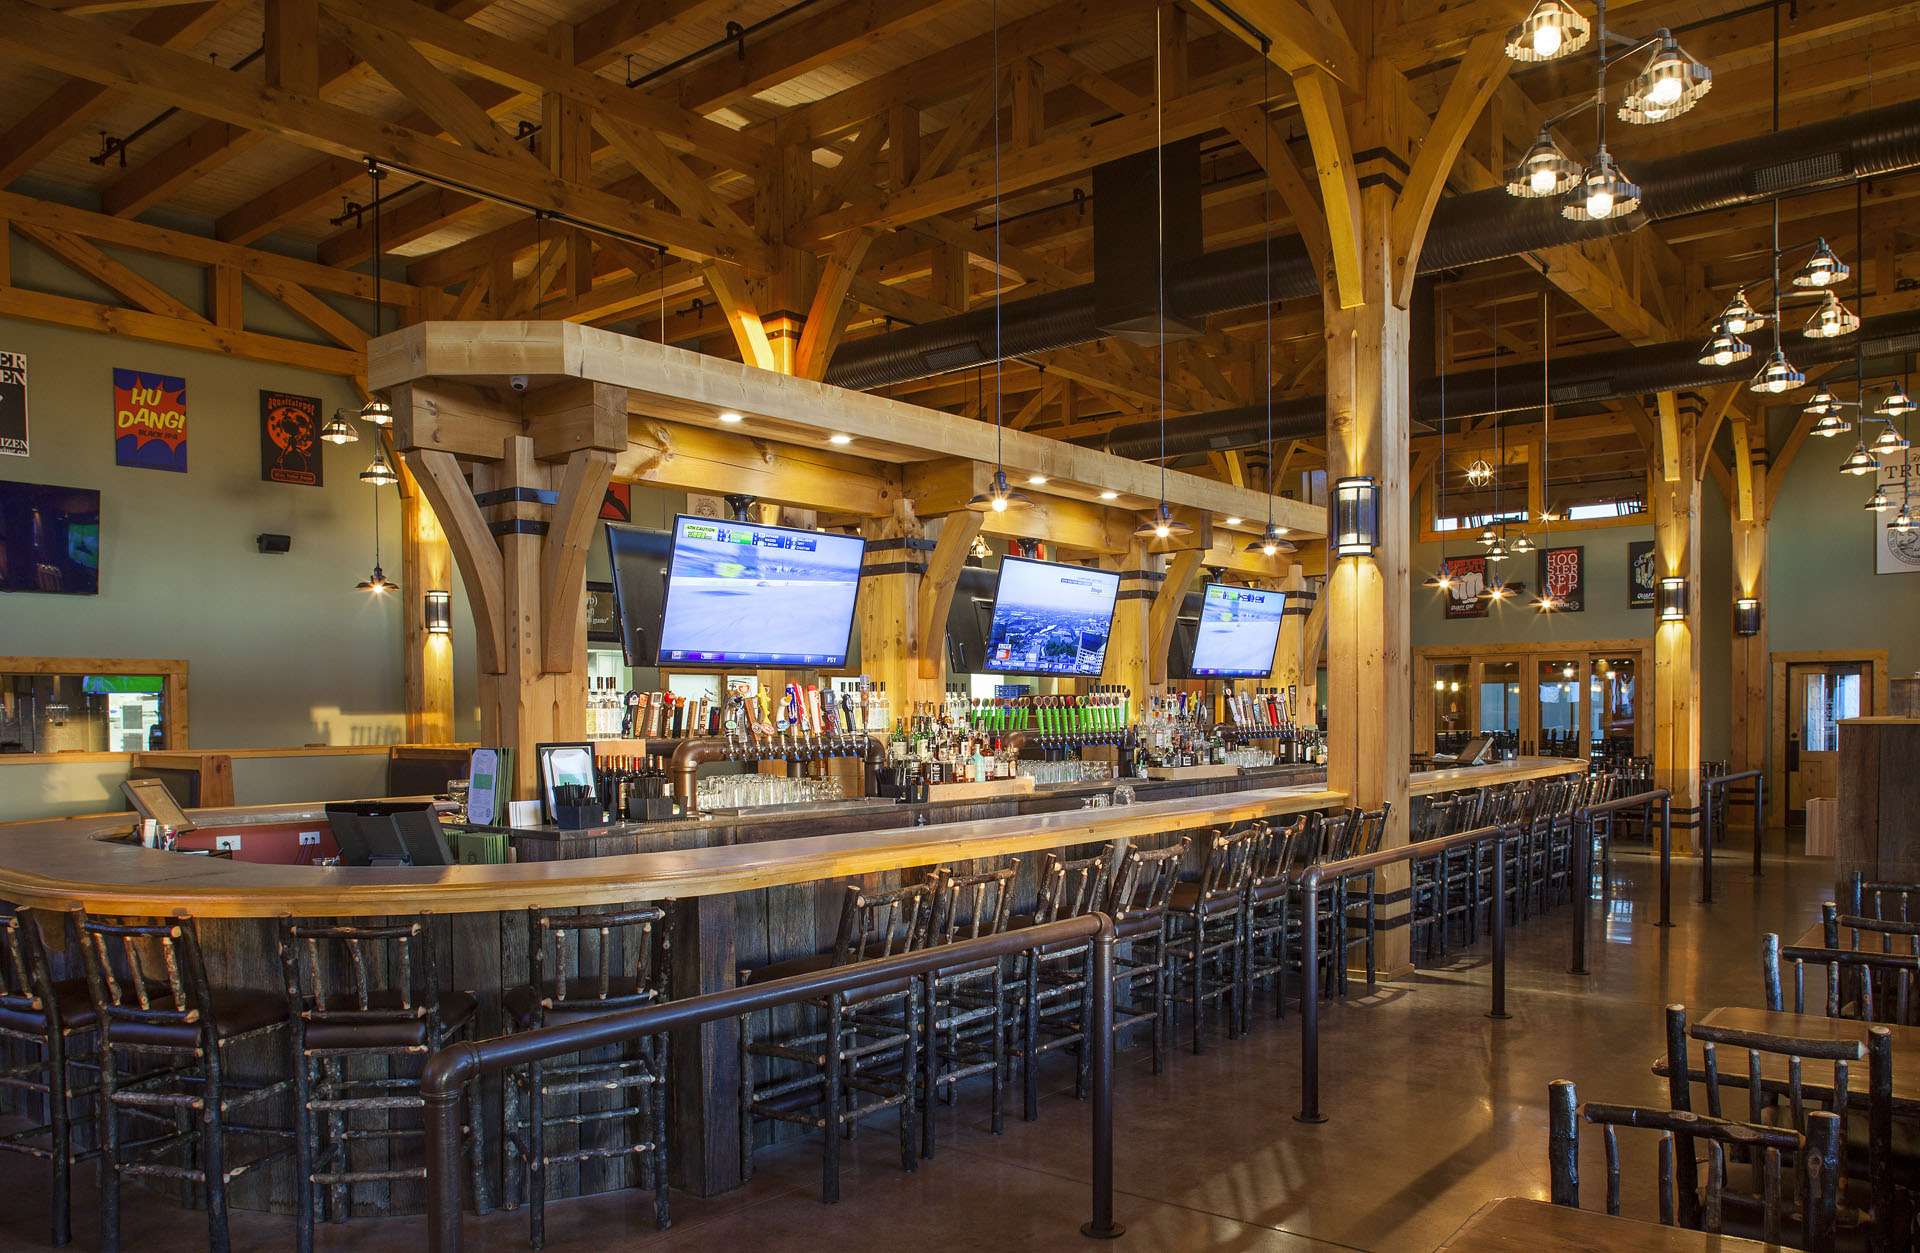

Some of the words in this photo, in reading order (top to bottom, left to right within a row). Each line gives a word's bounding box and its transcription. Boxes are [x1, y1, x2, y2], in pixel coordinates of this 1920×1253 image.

[131, 388, 162, 406] HU
[118, 408, 185, 433] DANG!
[1547, 553, 1578, 567] HOO
[1547, 574, 1578, 586] RED
